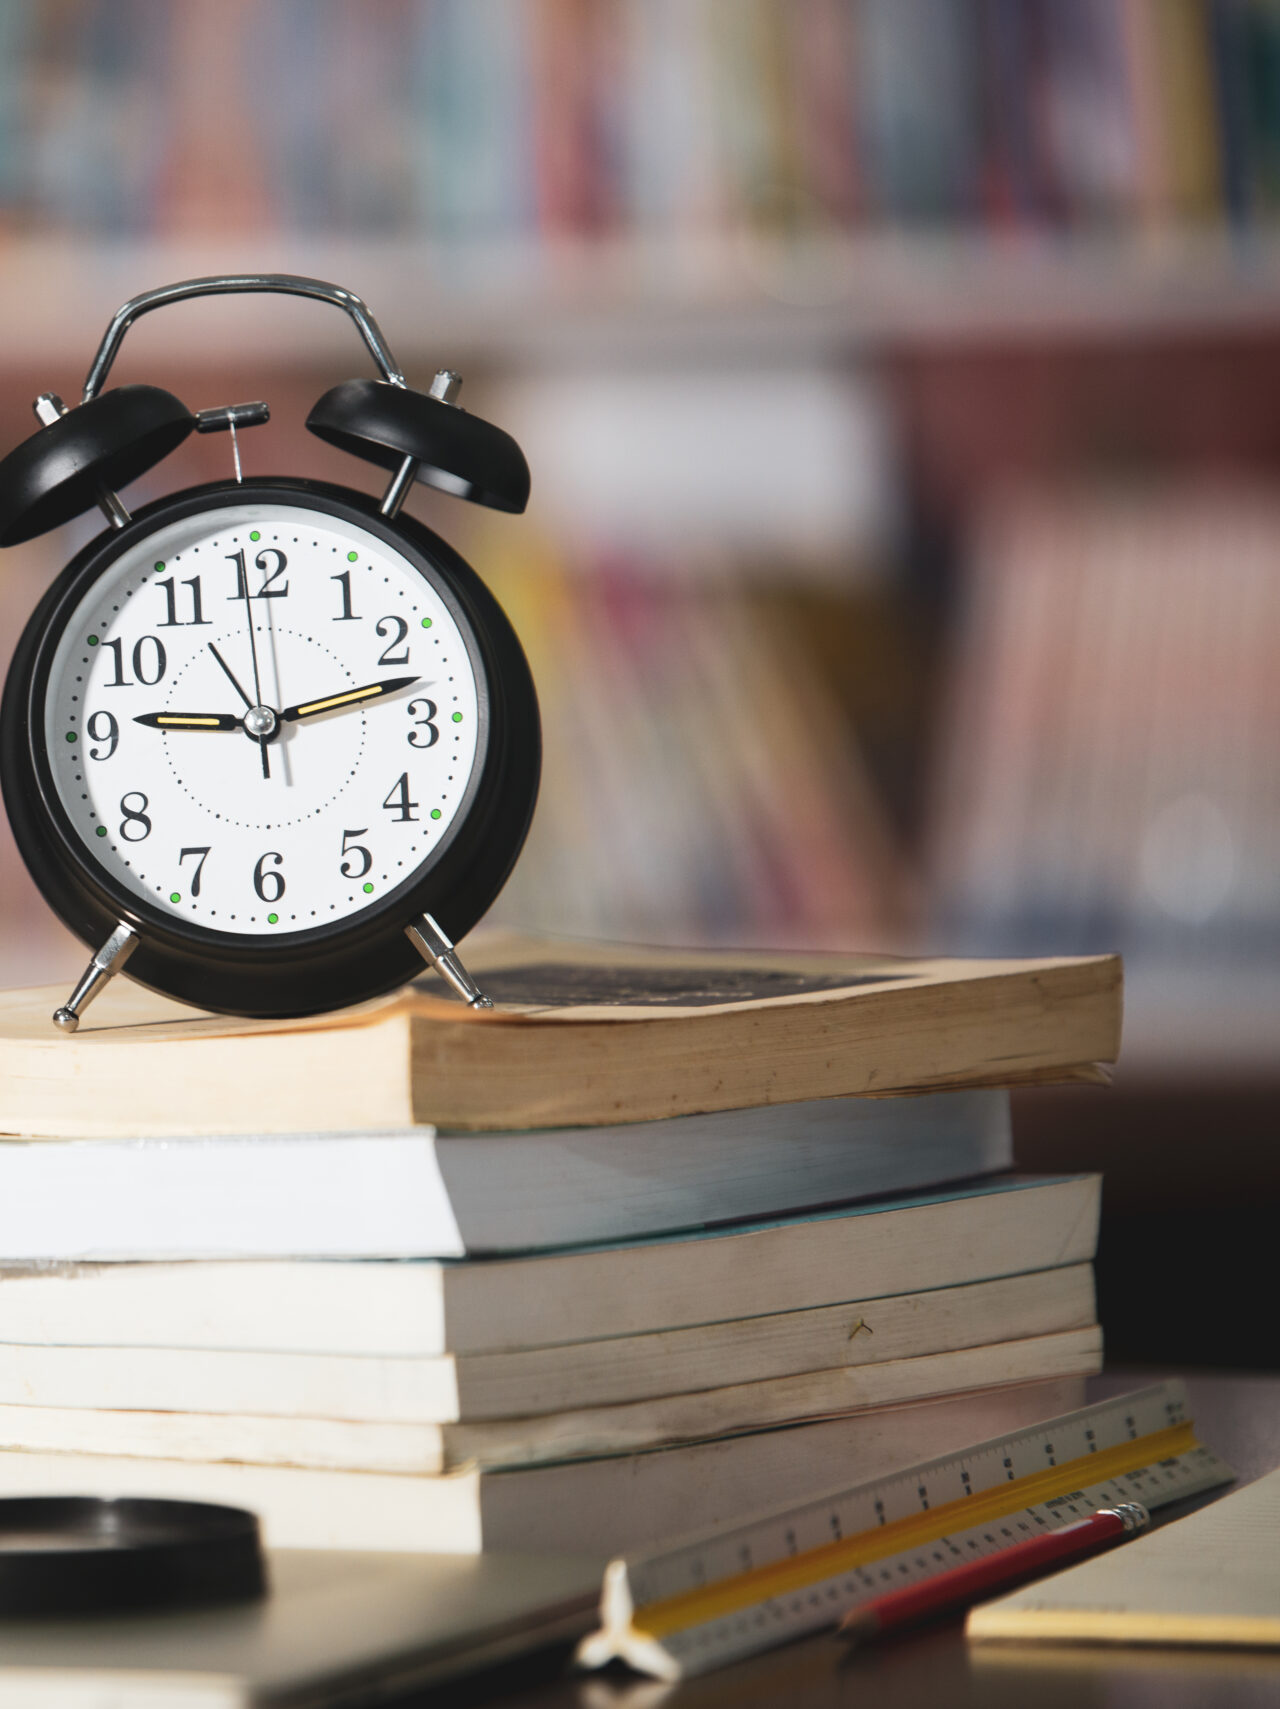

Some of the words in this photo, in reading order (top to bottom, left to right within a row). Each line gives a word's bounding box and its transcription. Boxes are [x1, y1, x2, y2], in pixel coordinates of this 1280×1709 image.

[225, 549, 290, 600] 12
[330, 570, 363, 621] 1
[155, 575, 213, 628] 11
[101, 635, 168, 688] 10
[375, 615, 411, 666] 2
[86, 710, 120, 761] 9
[406, 698, 440, 749] 3
[119, 791, 153, 842] 8
[381, 772, 420, 823] 4
[177, 846, 212, 898] 7
[253, 852, 286, 903] 6
[340, 828, 373, 879] 5
